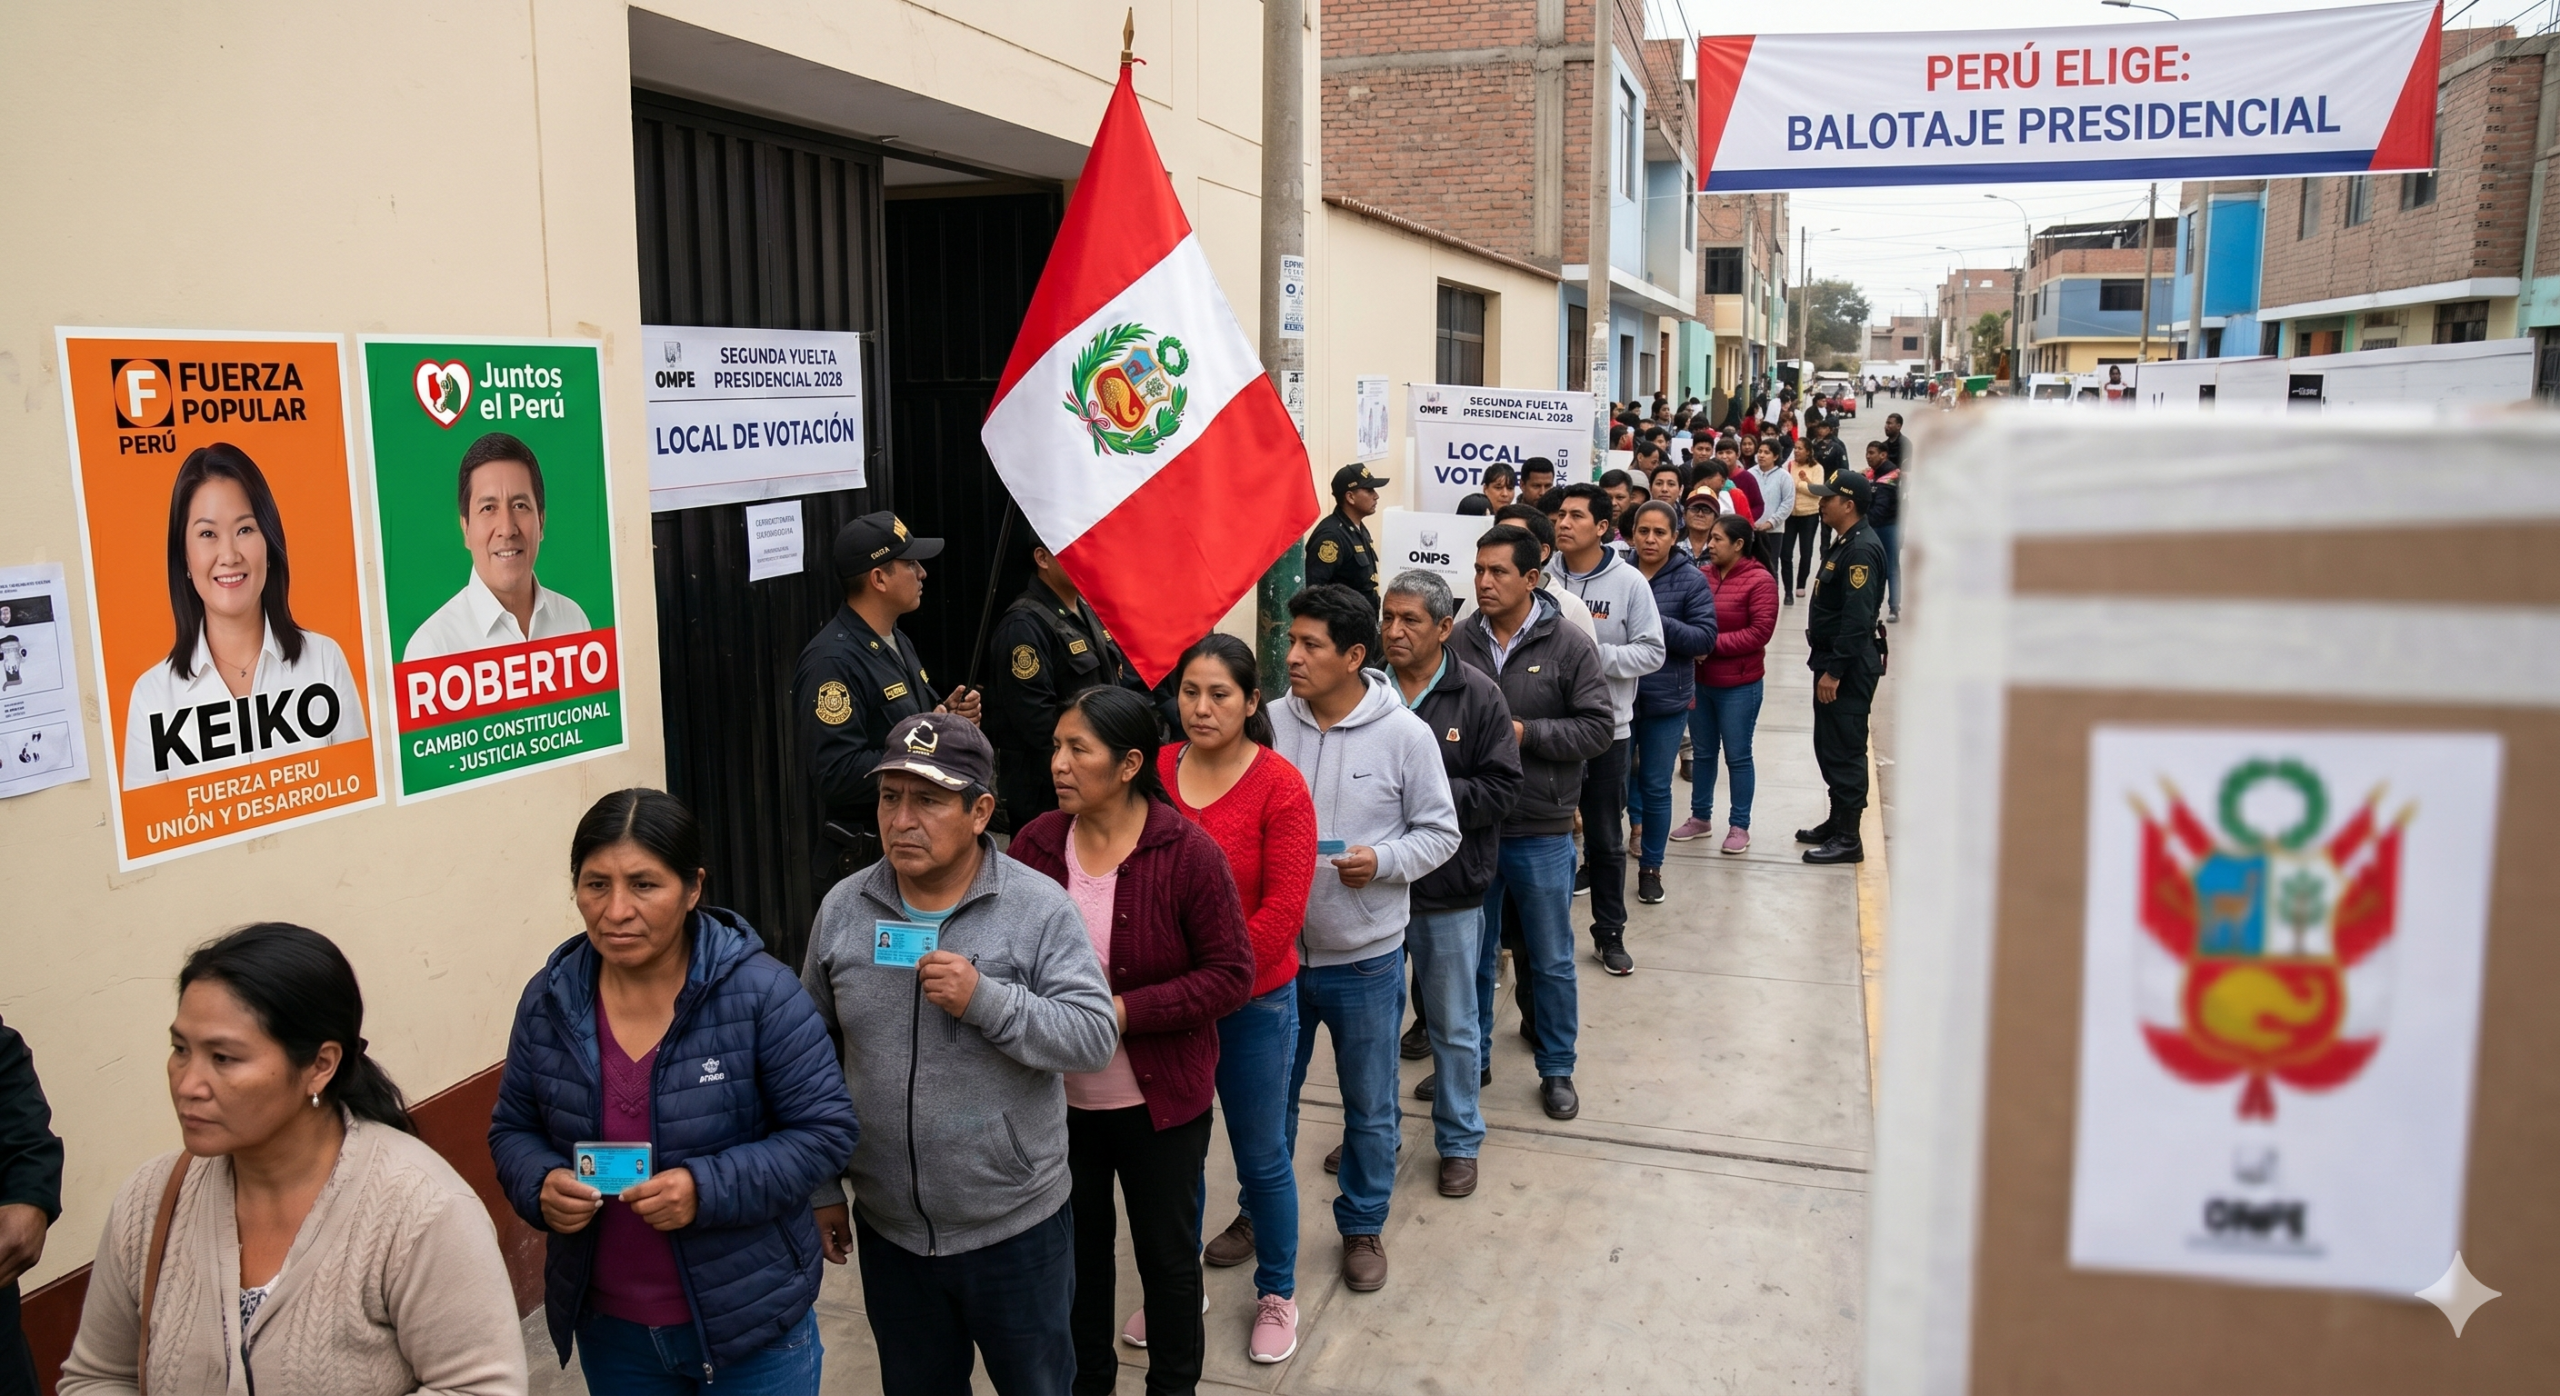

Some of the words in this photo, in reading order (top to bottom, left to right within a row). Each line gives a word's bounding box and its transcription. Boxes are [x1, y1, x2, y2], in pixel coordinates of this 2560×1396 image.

[1927, 42, 2040, 92] PERÚ
[2055, 45, 2190, 88] ELIGE:
[1787, 109, 2005, 151] BALOTAJE
[2018, 95, 2341, 144] PRESIDENCIAL
[720, 346, 787, 365] SEGUNDA
[788, 348, 837, 365] YUELTA
[179, 362, 304, 392] FUERZA
[479, 362, 563, 388] Juntos
[655, 370, 696, 388] OMPE
[714, 371, 812, 388] PRESIDENCIAL
[814, 371, 843, 387] 2028
[126, 370, 156, 418] F
[480, 392, 502, 420] el
[509, 391, 565, 419] Perú
[1469, 396, 1523, 409] SEGUNDA
[1525, 399, 1568, 411] FUELTA
[181, 398, 307, 424] POPULAR
[1419, 404, 1448, 415] OMPE
[1463, 408, 1544, 421] PRESIDENCIAL
[1546, 412, 1573, 423] 2028
[119, 429, 176, 455] PERÚ
[656, 424, 728, 455] LOCAL
[733, 422, 760, 450] DE
[763, 411, 855, 447] VOTACIÓN
[1447, 441, 1527, 464] LOCAL
[1408, 551, 1450, 565] ONPS
[407, 640, 609, 720] ROBERTO
[149, 682, 341, 773] KEIKO
[413, 729, 479, 758] CAMBIO
[483, 701, 610, 741] CONSTITUCIONAL
[459, 741, 528, 772] JUSTICIA
[530, 728, 583, 755] SOCIAL
[187, 773, 266, 808] FUERZA
[269, 759, 320, 788] PERU
[146, 808, 215, 844] UNIÓN
[219, 806, 233, 826] Y
[237, 774, 360, 821] DESARROLLO
